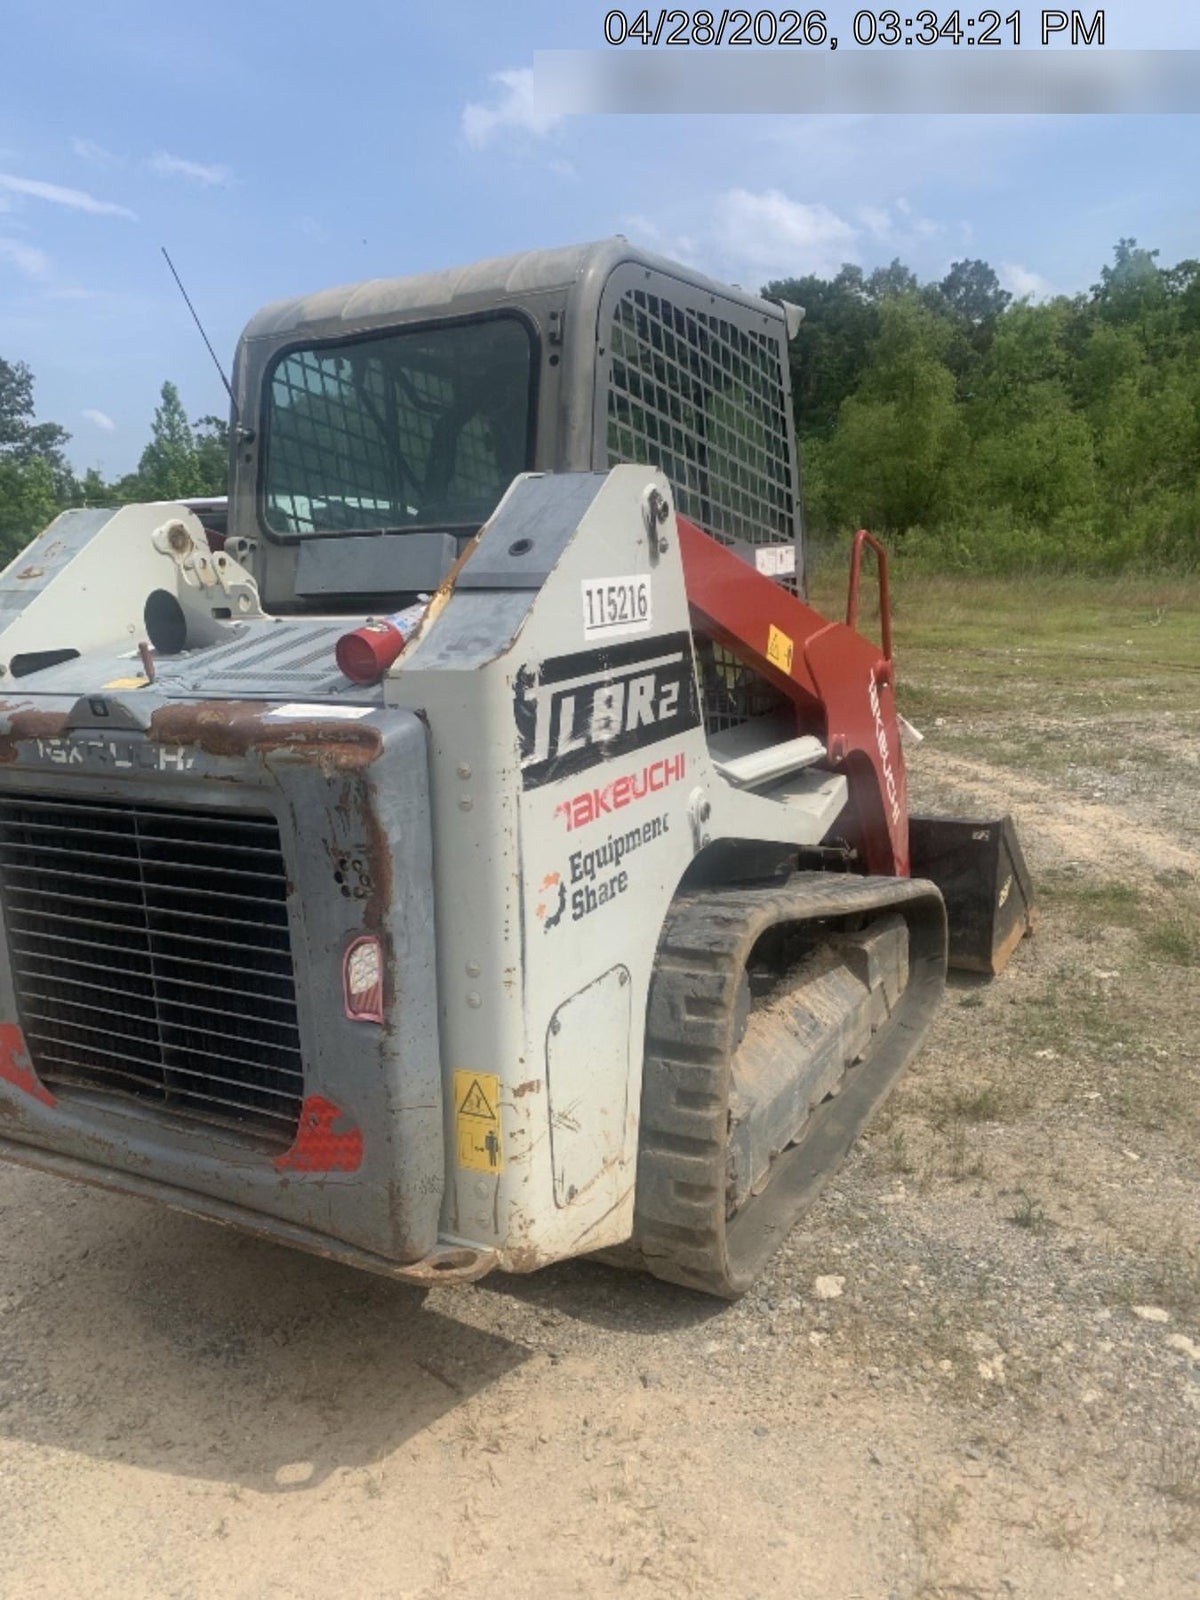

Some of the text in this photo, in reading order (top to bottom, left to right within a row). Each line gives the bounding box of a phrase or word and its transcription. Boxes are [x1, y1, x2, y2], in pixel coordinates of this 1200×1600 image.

[586, 582, 648, 625] 115216
[568, 812, 670, 885] Equipment
[571, 870, 629, 922] Share
